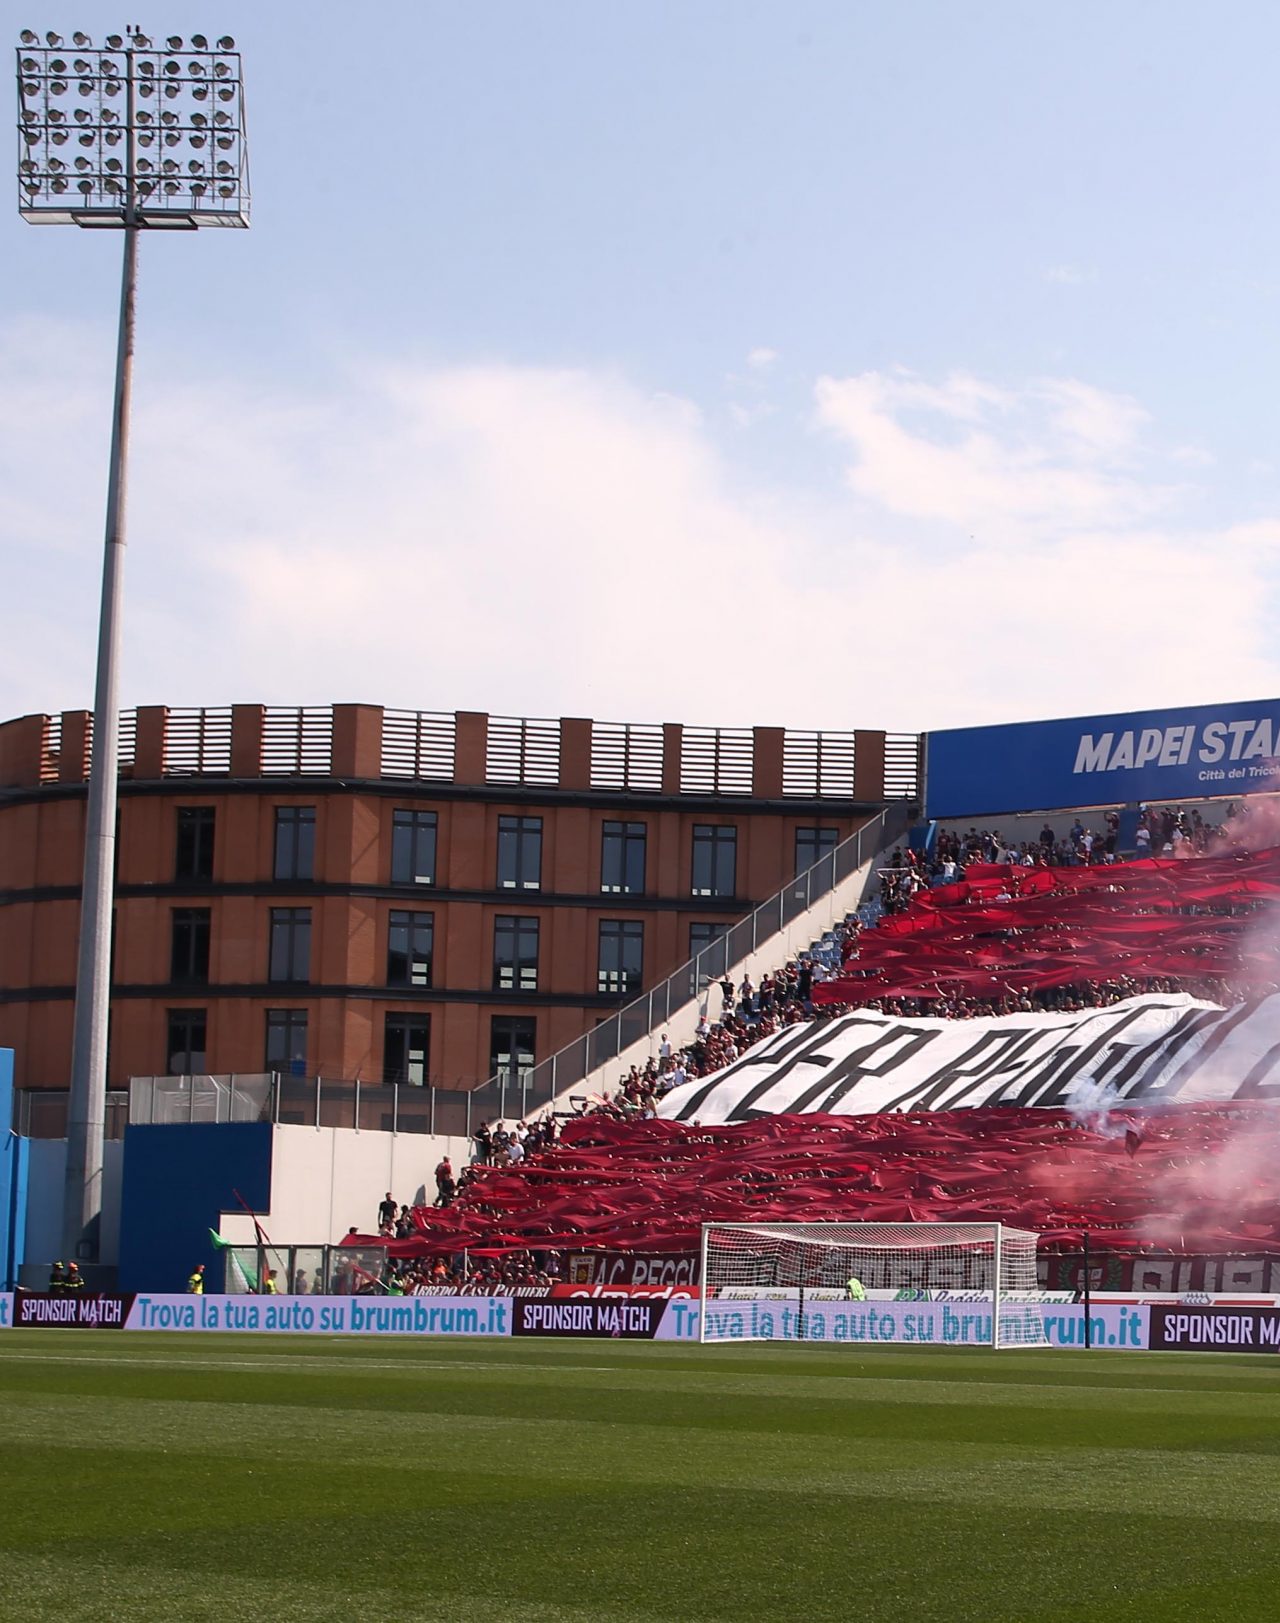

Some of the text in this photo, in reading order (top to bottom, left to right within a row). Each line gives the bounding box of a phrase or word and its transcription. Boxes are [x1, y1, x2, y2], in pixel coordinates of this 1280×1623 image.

[1073, 725, 1196, 774] MAPEI
[1198, 769, 1226, 782] Città
[1228, 767, 1246, 779] del
[675, 1017, 943, 1122] PER
[411, 1284, 551, 1298] ARREDO CASA PALMIERI
[21, 1299, 76, 1322] SPONSOR
[79, 1300, 122, 1323] MATCH
[138, 1297, 506, 1333] Trova la tua auto su brumbrum.it
[523, 1304, 650, 1332] SPONSOR MATCH
[671, 1304, 744, 1338] Trova
[751, 1303, 774, 1339] la
[781, 1307, 826, 1341] tua
[833, 1308, 896, 1341] auto
[903, 1313, 934, 1342] su
[1164, 1314, 1253, 1344] SPONSOR
